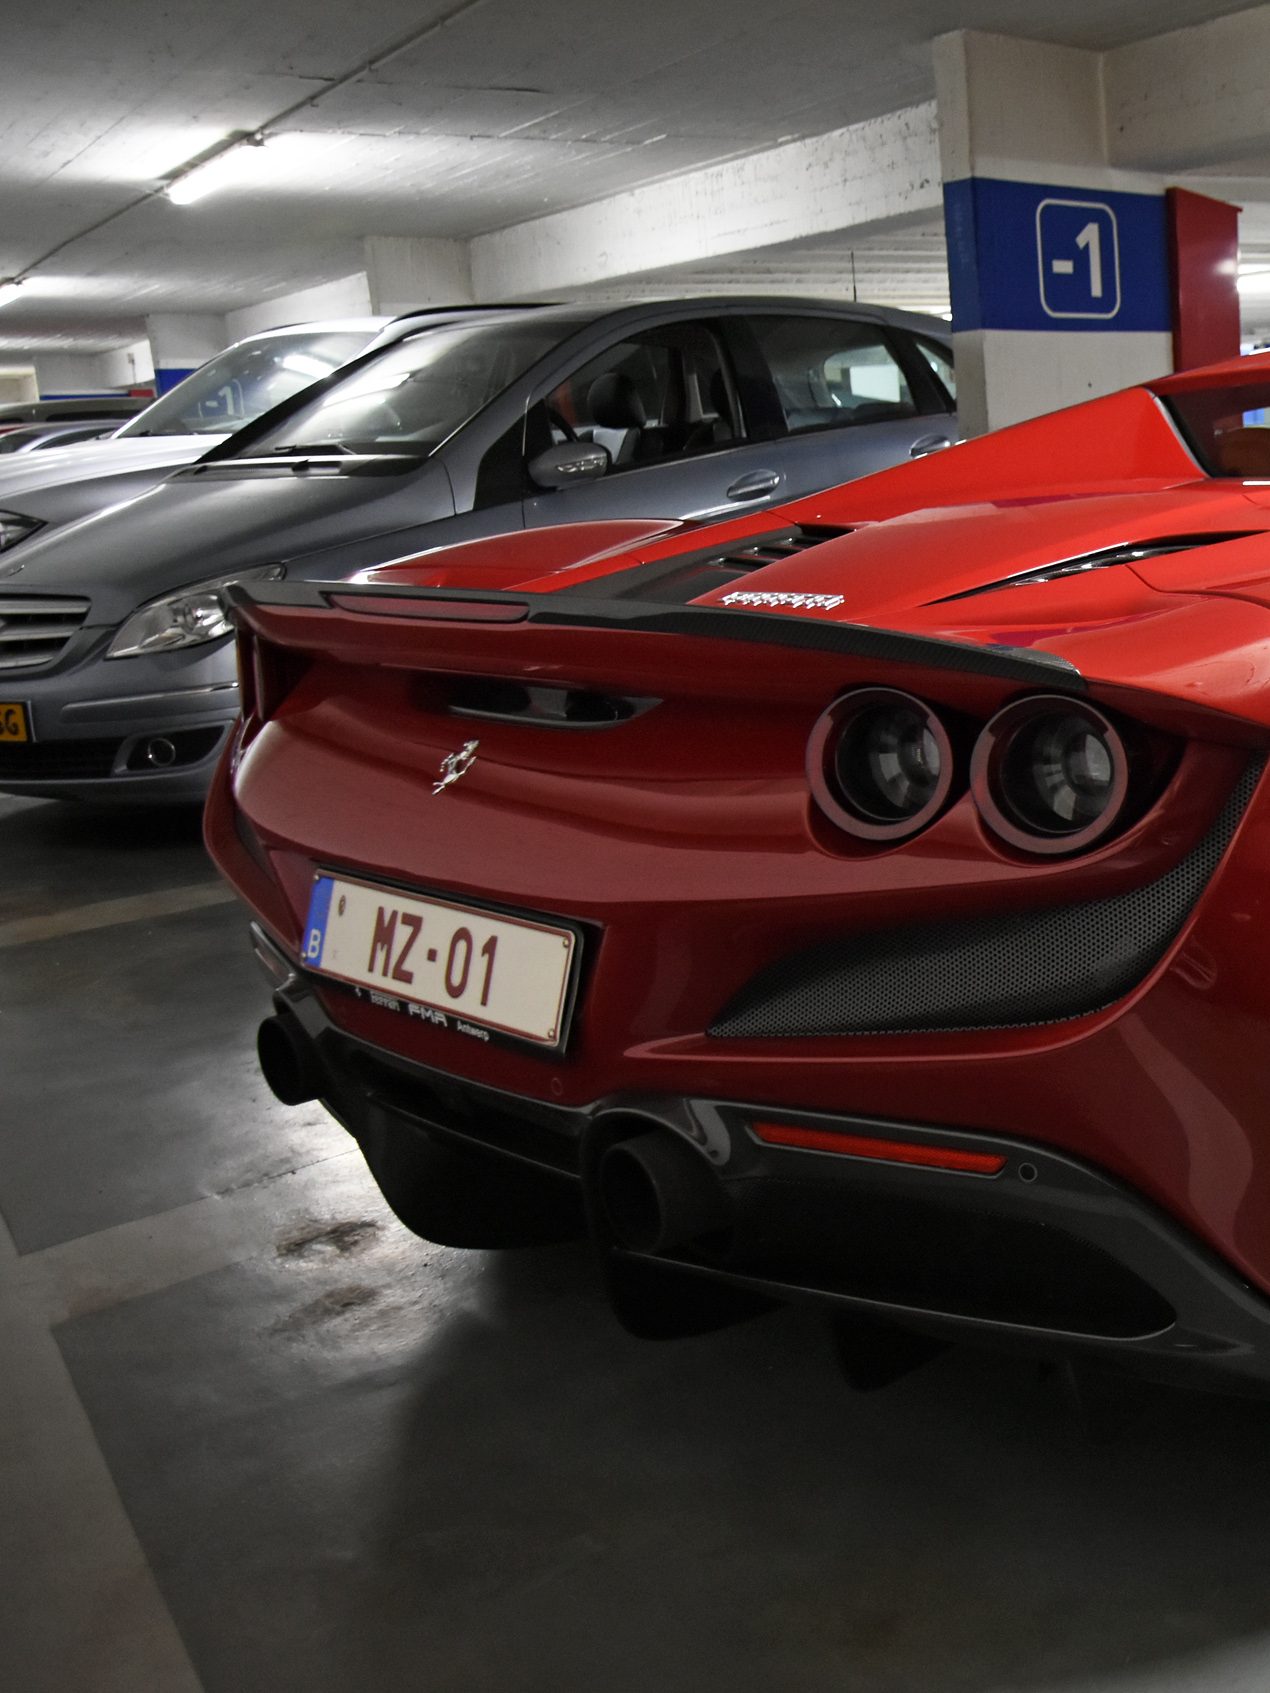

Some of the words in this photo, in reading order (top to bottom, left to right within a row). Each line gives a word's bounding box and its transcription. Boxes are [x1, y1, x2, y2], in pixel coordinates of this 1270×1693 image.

[1052, 222, 1102, 298] -1
[0, 708, 20, 736] G
[307, 928, 322, 959] B
